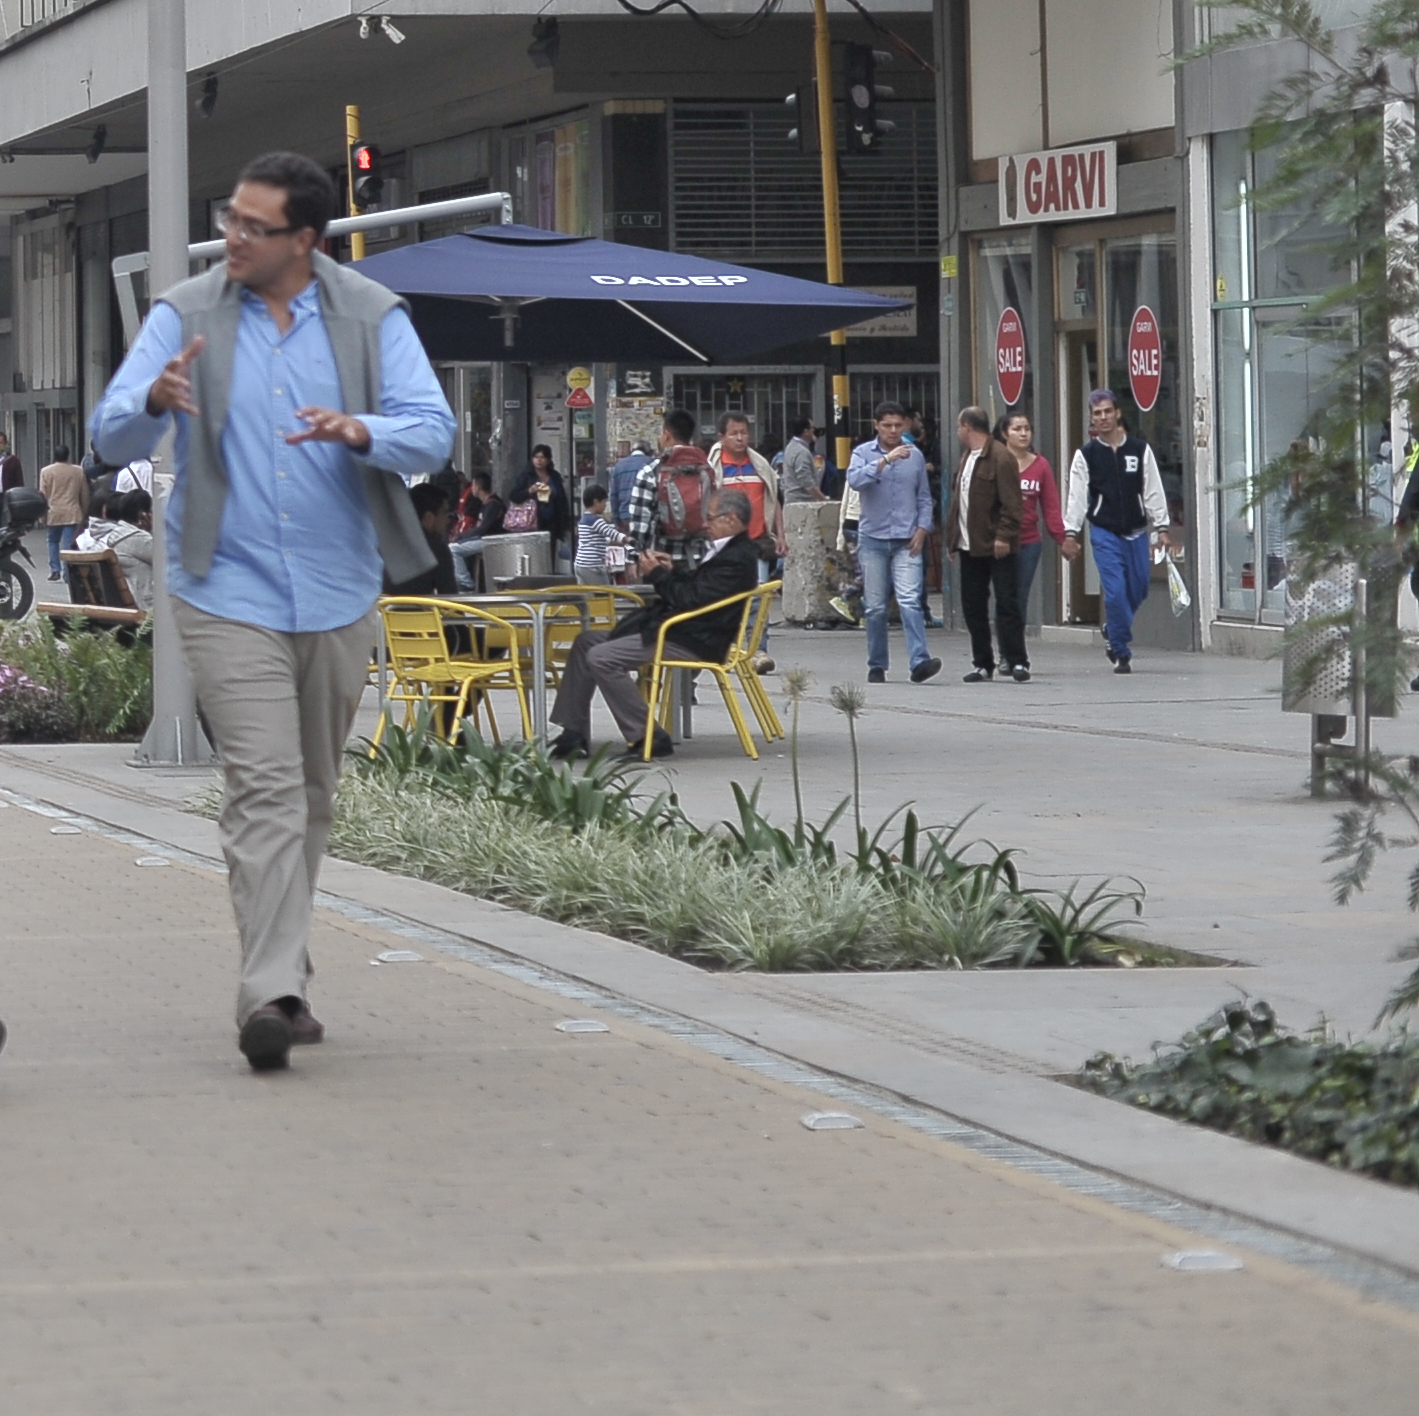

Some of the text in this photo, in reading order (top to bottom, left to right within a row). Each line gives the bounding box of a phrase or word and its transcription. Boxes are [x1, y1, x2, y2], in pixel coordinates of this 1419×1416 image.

[1024, 149, 1106, 216] GARVI
[590, 275, 748, 286] DADEP
[998, 346, 1023, 374] SALE
[1131, 348, 1159, 377] SALE
[1124, 455, 1139, 473] B
